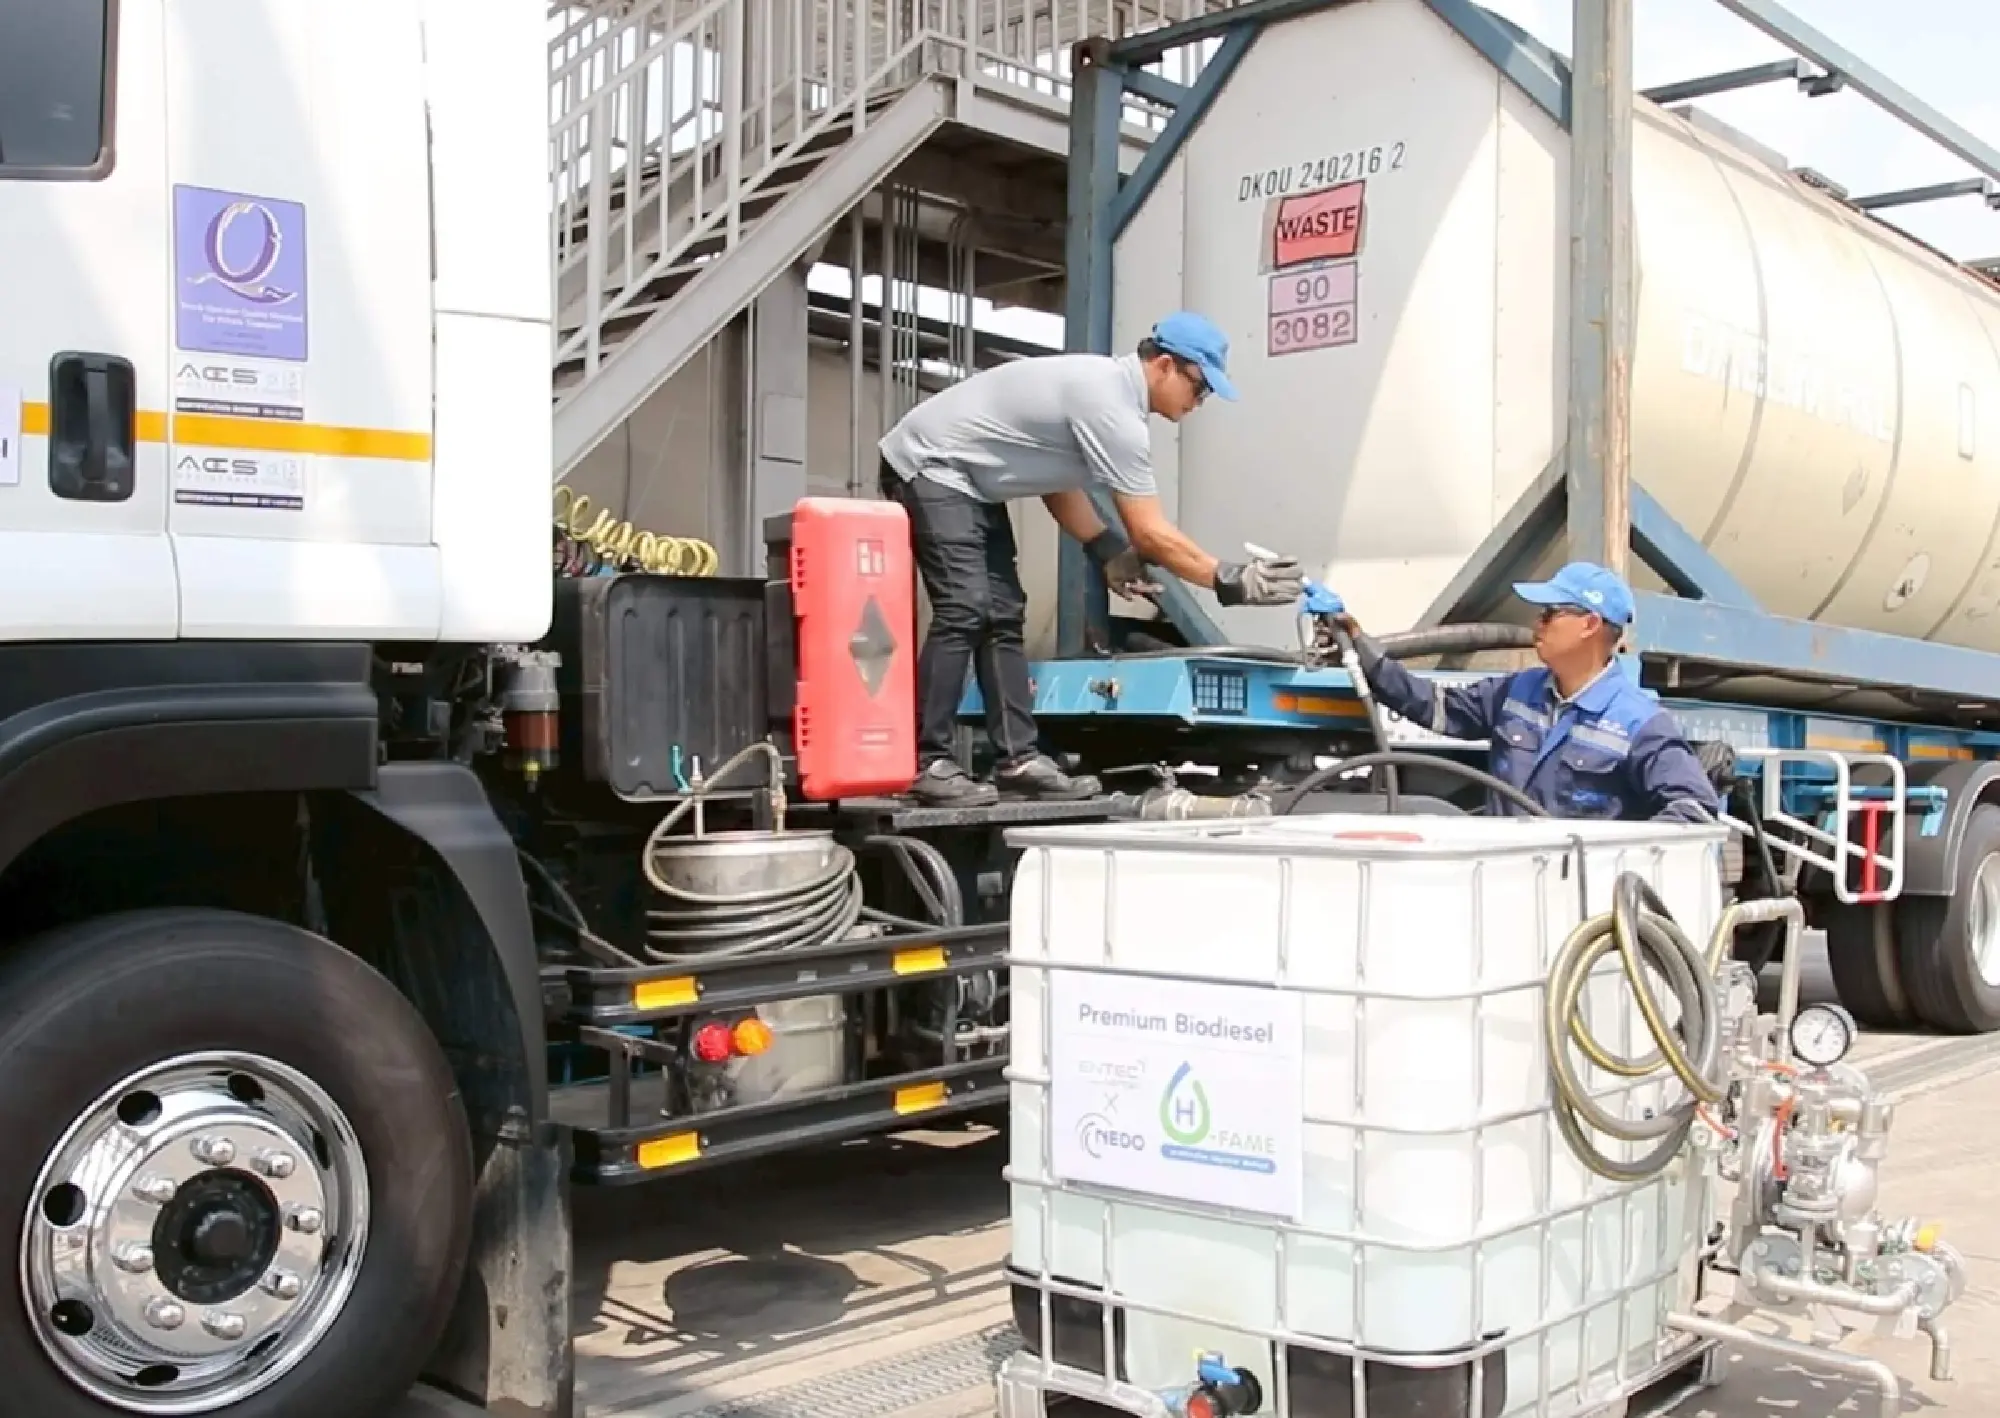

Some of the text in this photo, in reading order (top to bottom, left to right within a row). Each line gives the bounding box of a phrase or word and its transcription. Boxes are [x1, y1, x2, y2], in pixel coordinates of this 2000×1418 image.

[1299, 146, 1383, 189] 240216
[1390, 140, 1406, 170] 2
[1278, 205, 1358, 241] WASTE
[1295, 274, 1330, 304] 90
[1273, 309, 1351, 346] 3082
[1079, 1003, 1275, 1044] Premium Biodiesel
[1095, 1128, 1146, 1151] NEDO
